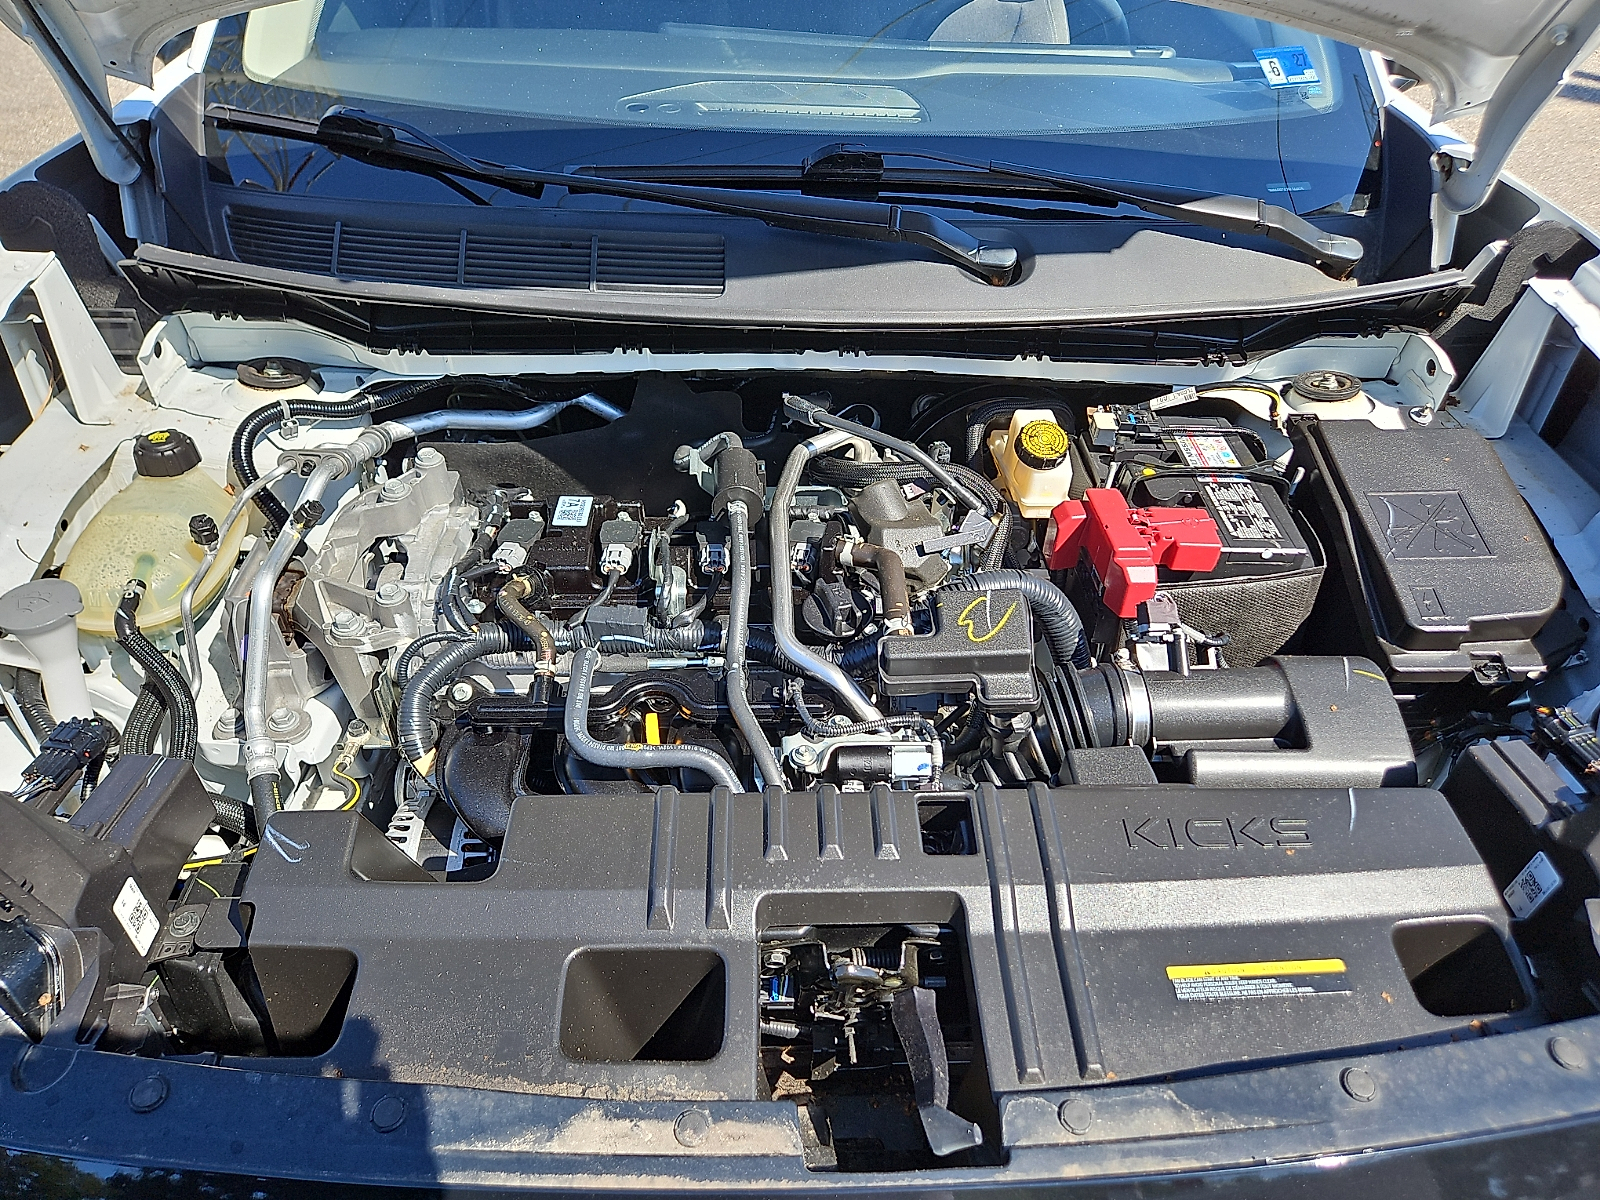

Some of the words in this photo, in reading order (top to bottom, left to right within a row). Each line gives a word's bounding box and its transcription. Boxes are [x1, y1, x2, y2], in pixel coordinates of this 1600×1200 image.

[1291, 53, 1307, 67] 27
[1268, 60, 1281, 77] 6
[565, 498, 581, 508] 7A
[1121, 816, 1314, 850] KICKS
